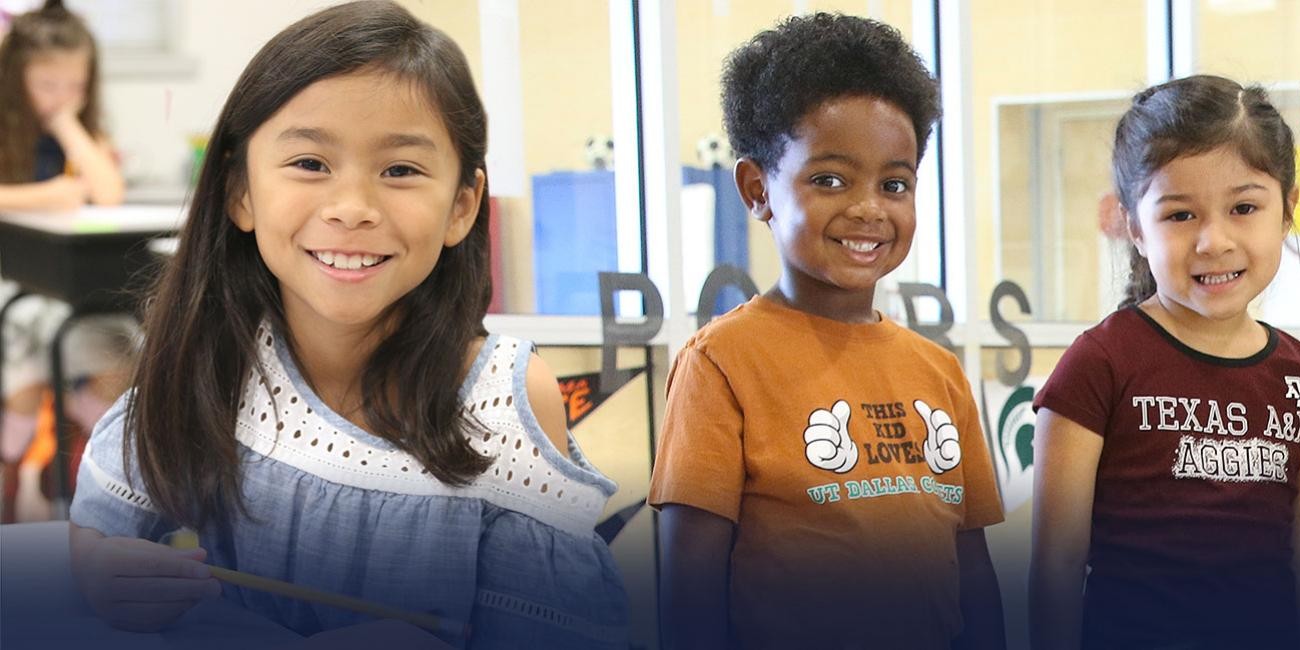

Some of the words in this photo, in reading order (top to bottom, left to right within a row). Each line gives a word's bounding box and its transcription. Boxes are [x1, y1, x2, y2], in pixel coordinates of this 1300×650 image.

[862, 402, 906, 419] THIS
[1132, 396, 1249, 436] TEXAS
[873, 422, 906, 439] KID
[1178, 442, 1286, 480] AGGIES
[807, 483, 840, 505] UT
